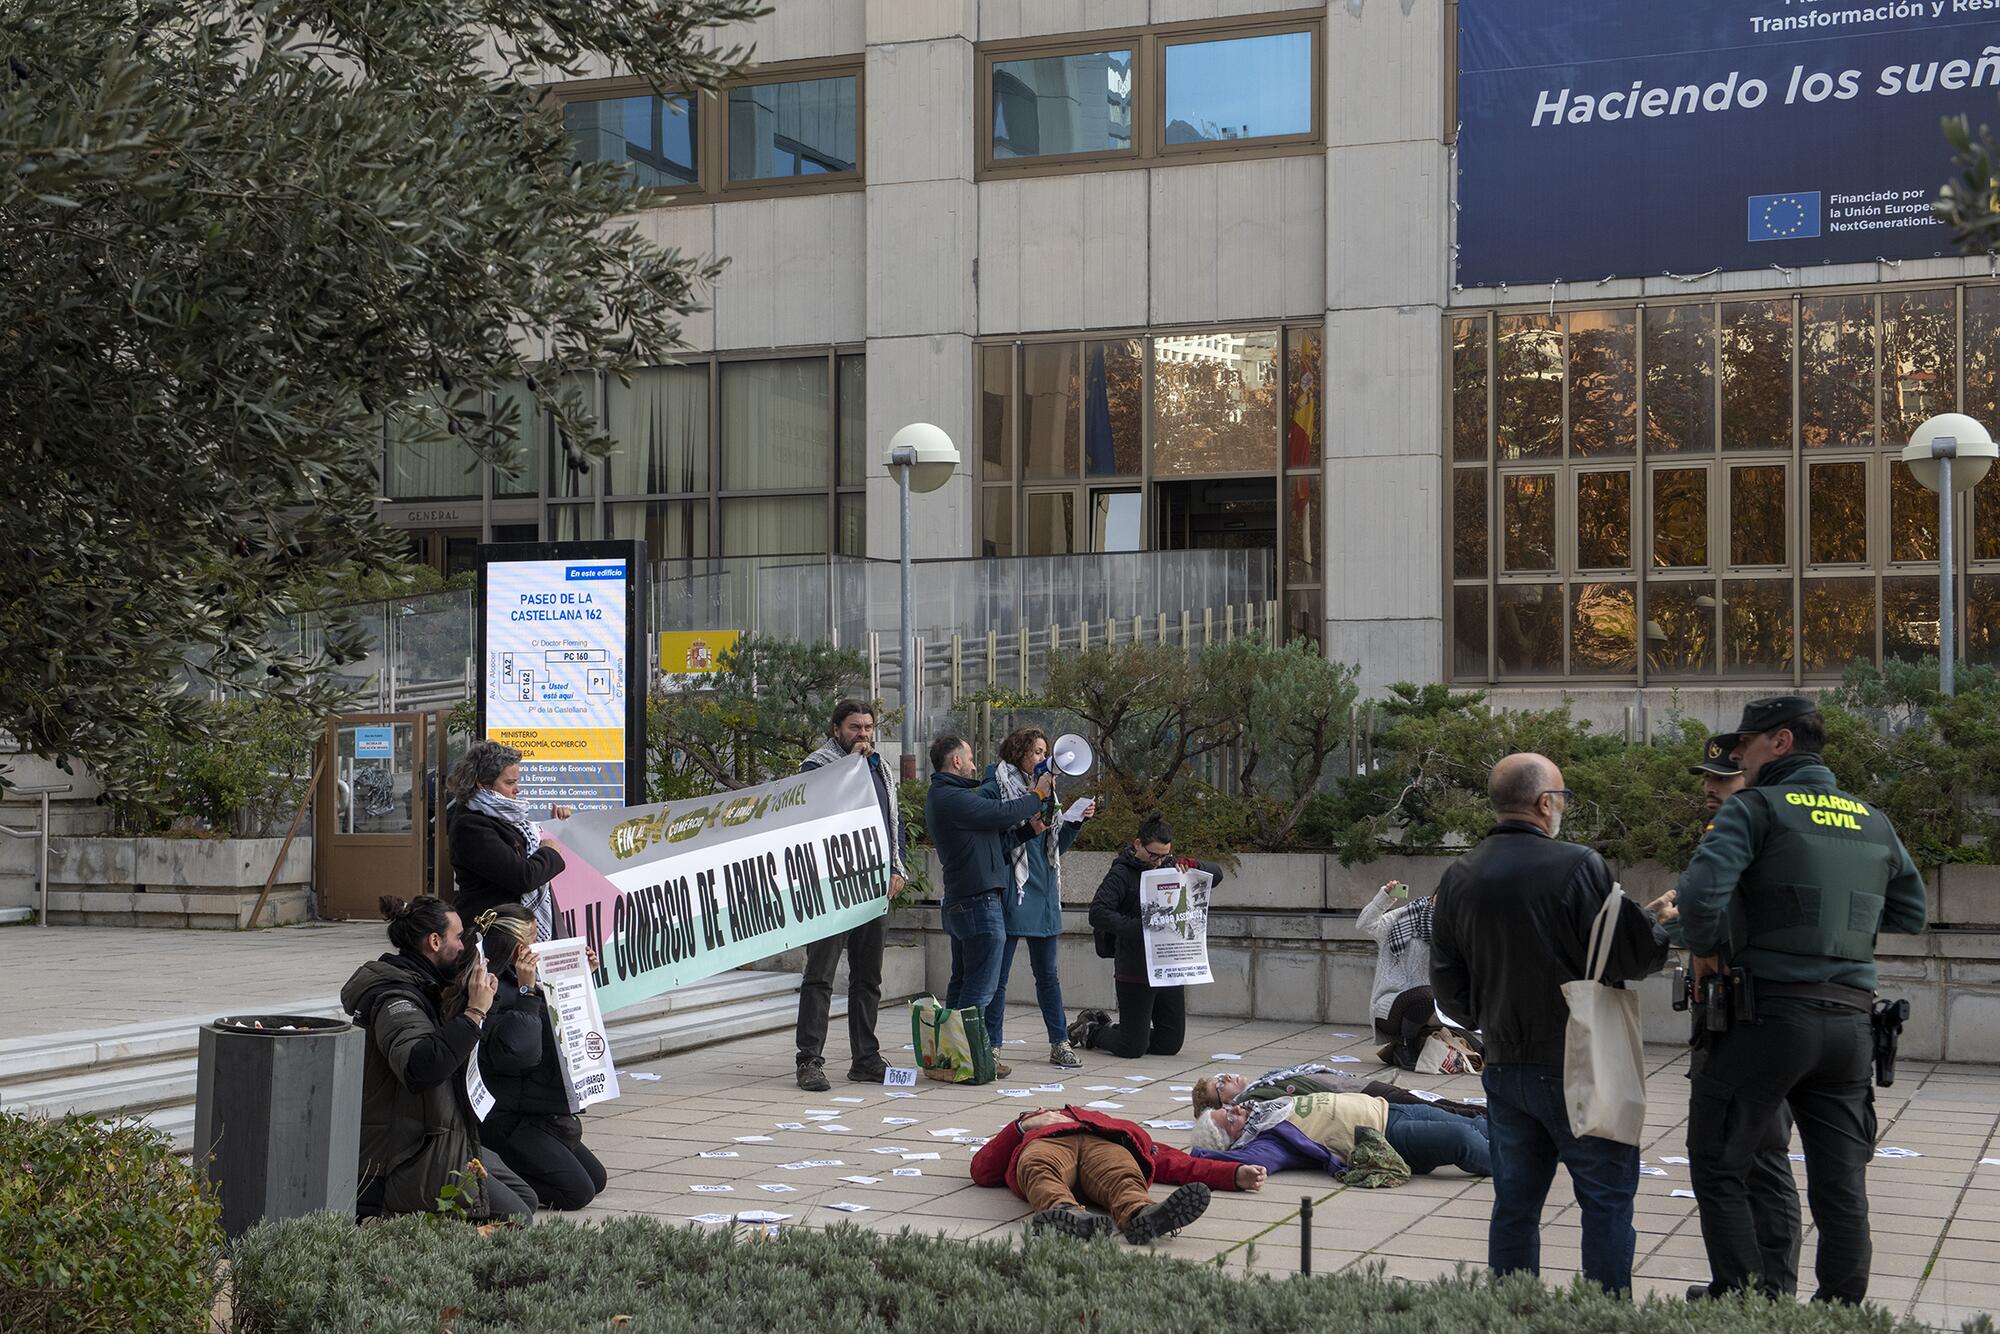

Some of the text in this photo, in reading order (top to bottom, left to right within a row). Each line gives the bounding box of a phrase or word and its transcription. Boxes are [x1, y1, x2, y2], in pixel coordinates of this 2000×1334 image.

[1750, 2, 1924, 34] Transformación
[1931, 1, 1944, 18] y
[1531, 72, 1768, 127] Haciendo
[1784, 65, 1862, 104] los
[1830, 189, 1925, 204] Financiado por
[1830, 208, 1841, 218] la
[1844, 205, 1881, 217] Unión
[408, 510, 459, 521] GENERAL
[520, 593, 592, 604] PASEO DE LA
[511, 609, 602, 621] CASTELLANA 162
[563, 640, 588, 648] Fleming
[576, 652, 588, 660] 160
[504, 660, 512, 676] AA2
[523, 687, 530, 699] PC
[559, 692, 574, 701] aquí
[512, 740, 549, 748] ECONOMÍA,
[568, 764, 596, 772] Economía
[597, 766, 602, 774] y
[532, 774, 556, 783] Empresa
[568, 788, 597, 796] Comercio
[578, 802, 607, 810] Comercio
[1785, 792, 1870, 816] GUARDIA
[1810, 810, 1862, 830] CIVIL
[617, 825, 636, 854] FIN
[668, 816, 705, 838] COMERCIO
[614, 875, 696, 982] COMERCIO
[696, 868, 725, 951] DE
[723, 851, 786, 943] ARMAS
[784, 842, 826, 924] CON
[822, 826, 888, 911] ISRAEL
